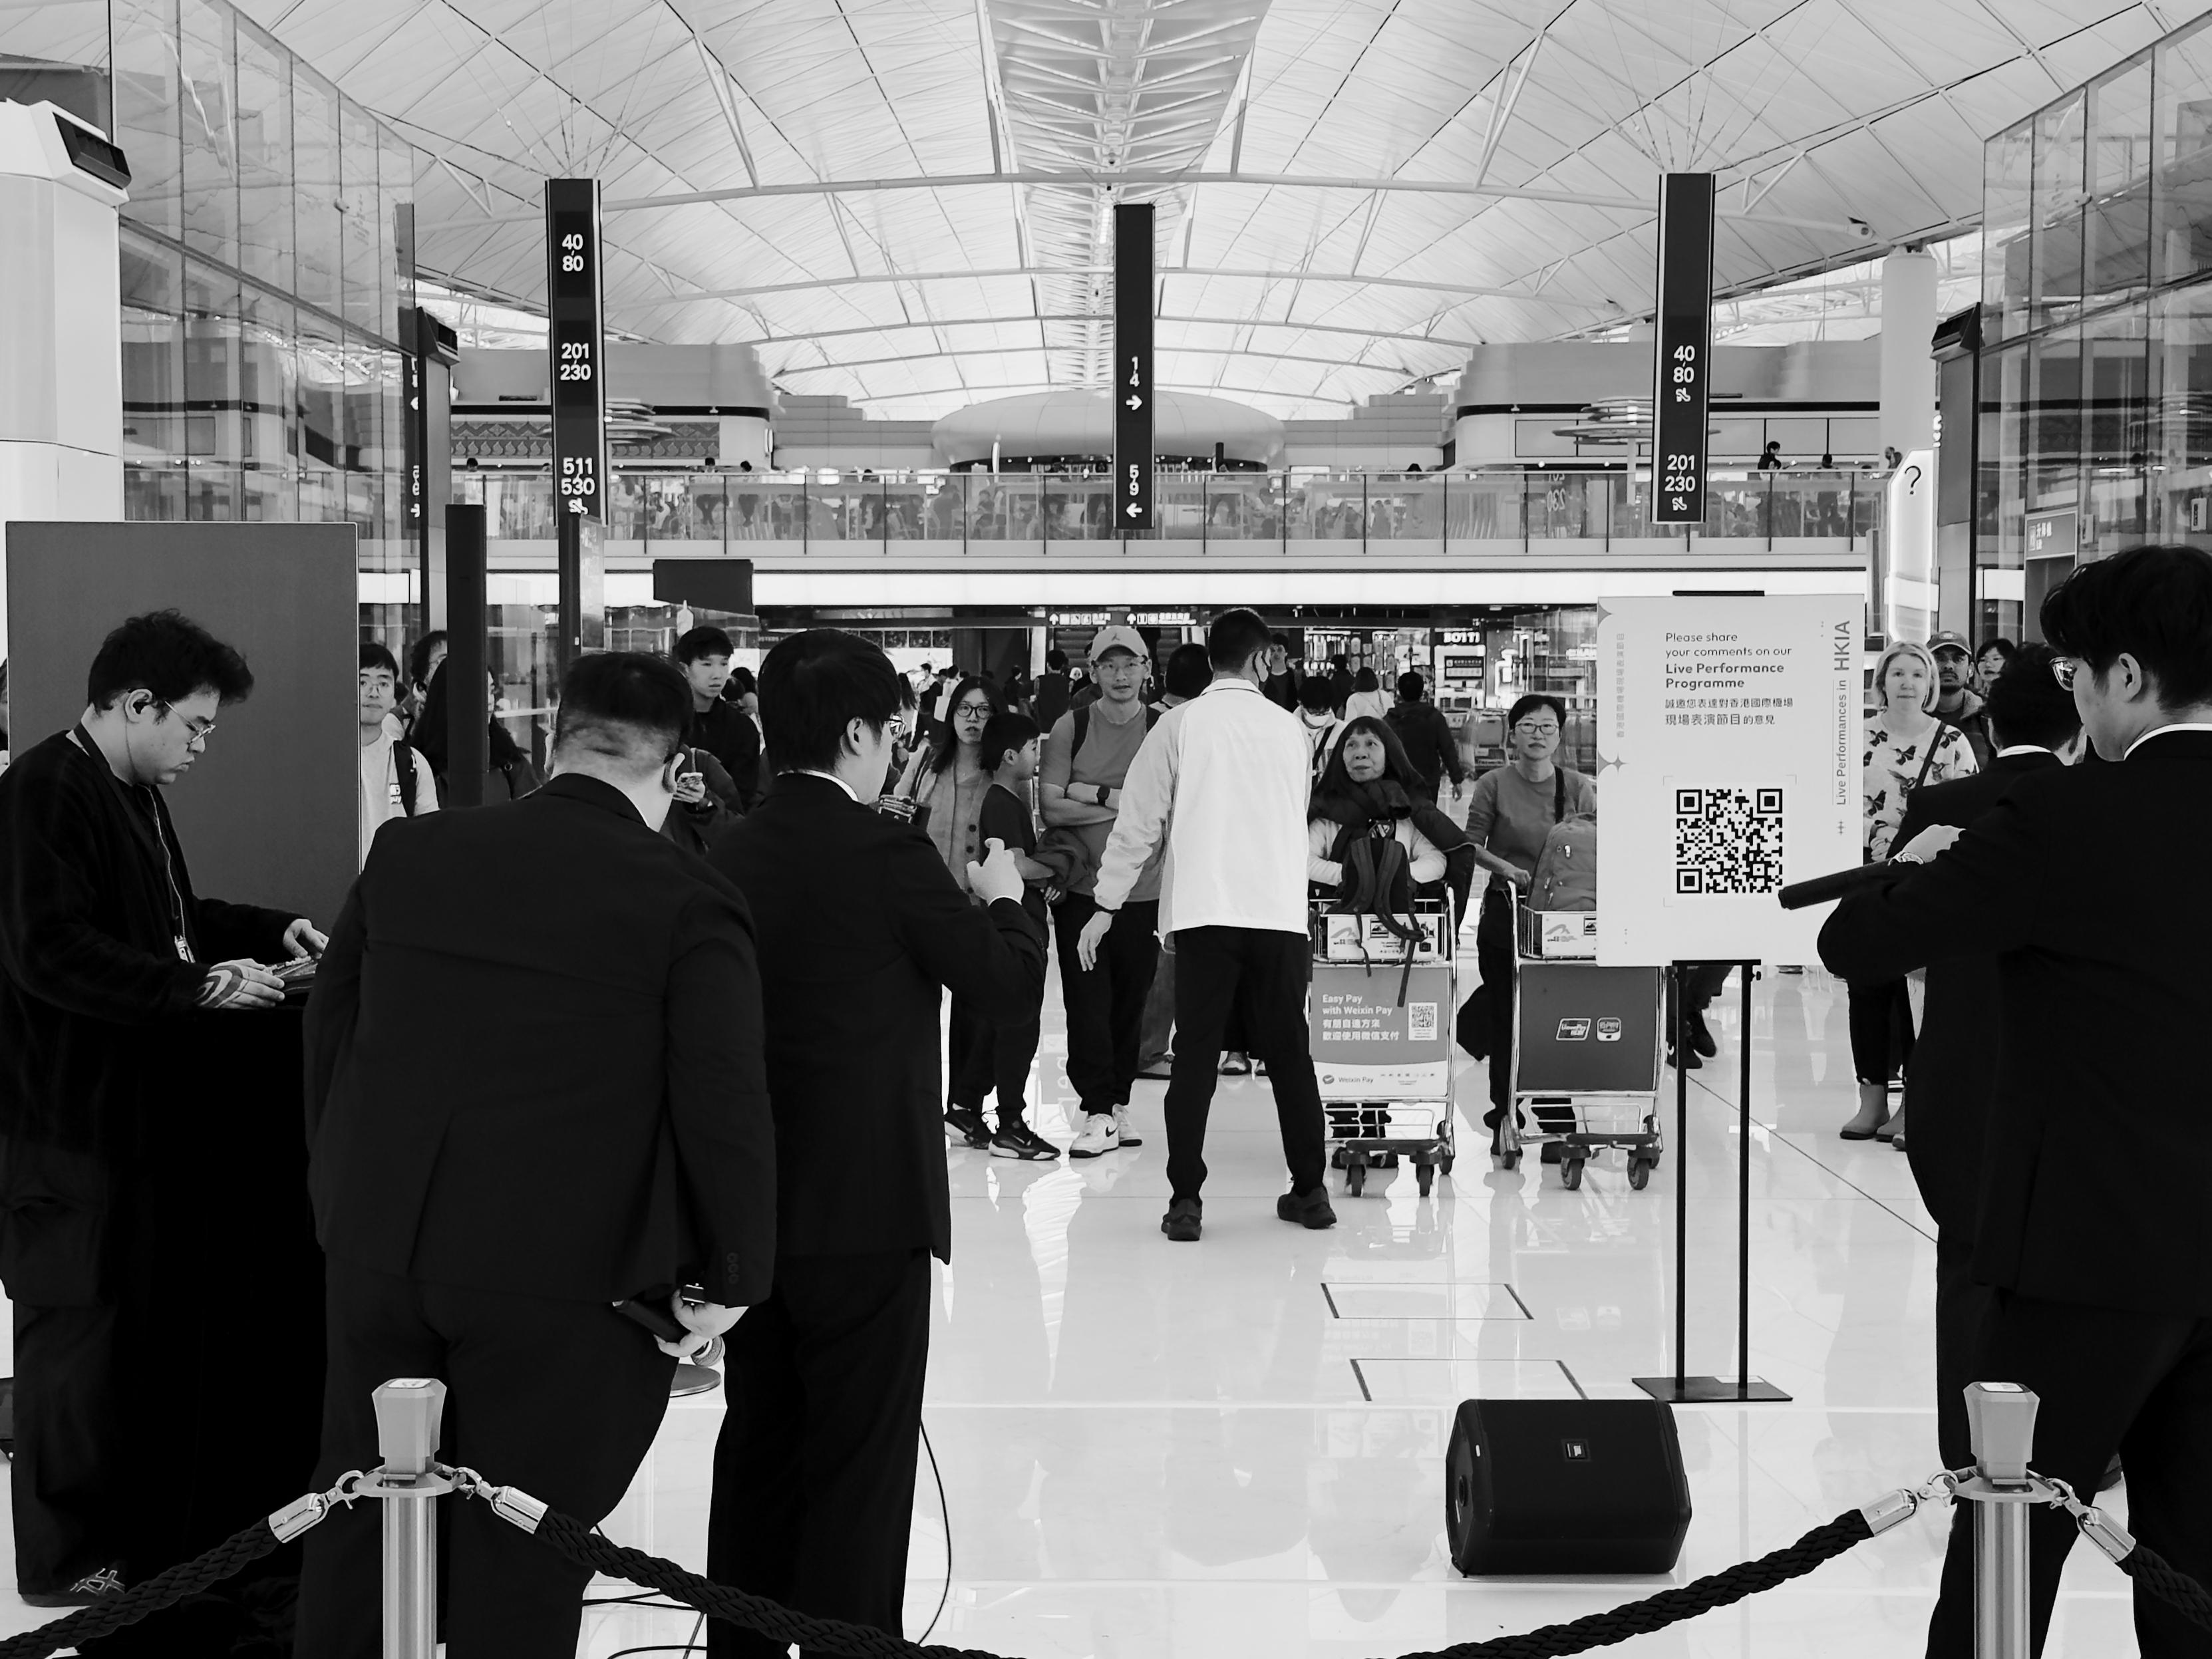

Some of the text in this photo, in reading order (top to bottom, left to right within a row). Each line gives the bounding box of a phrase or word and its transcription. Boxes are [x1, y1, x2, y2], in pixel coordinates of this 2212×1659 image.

[562, 234, 583, 250] 40
[563, 256, 583, 271] 80
[561, 343, 589, 359] 201
[1674, 345, 1694, 361] 40
[1132, 357, 1138, 371] 1
[560, 364, 591, 380] 230
[1673, 367, 1694, 382] 80
[1130, 373, 1140, 387] 4
[563, 458, 592, 475] 511
[1667, 454, 1694, 470] 201
[1130, 464, 1139, 479] 5
[561, 478, 595, 495] 530
[1130, 482, 1139, 496] 9
[1664, 476, 1695, 492] 230
[1666, 633, 1738, 642] Please share
[1666, 649, 1690, 659] your
[1694, 647, 1752, 657] comments
[1666, 663, 1784, 673] Live Performance
[1666, 678, 1745, 691] Programme
[1833, 621, 1850, 805] Live Performances in HKIA
[1323, 994, 1362, 1004] Easy Pay
[1323, 1006, 1392, 1016] with Weixin Pay
